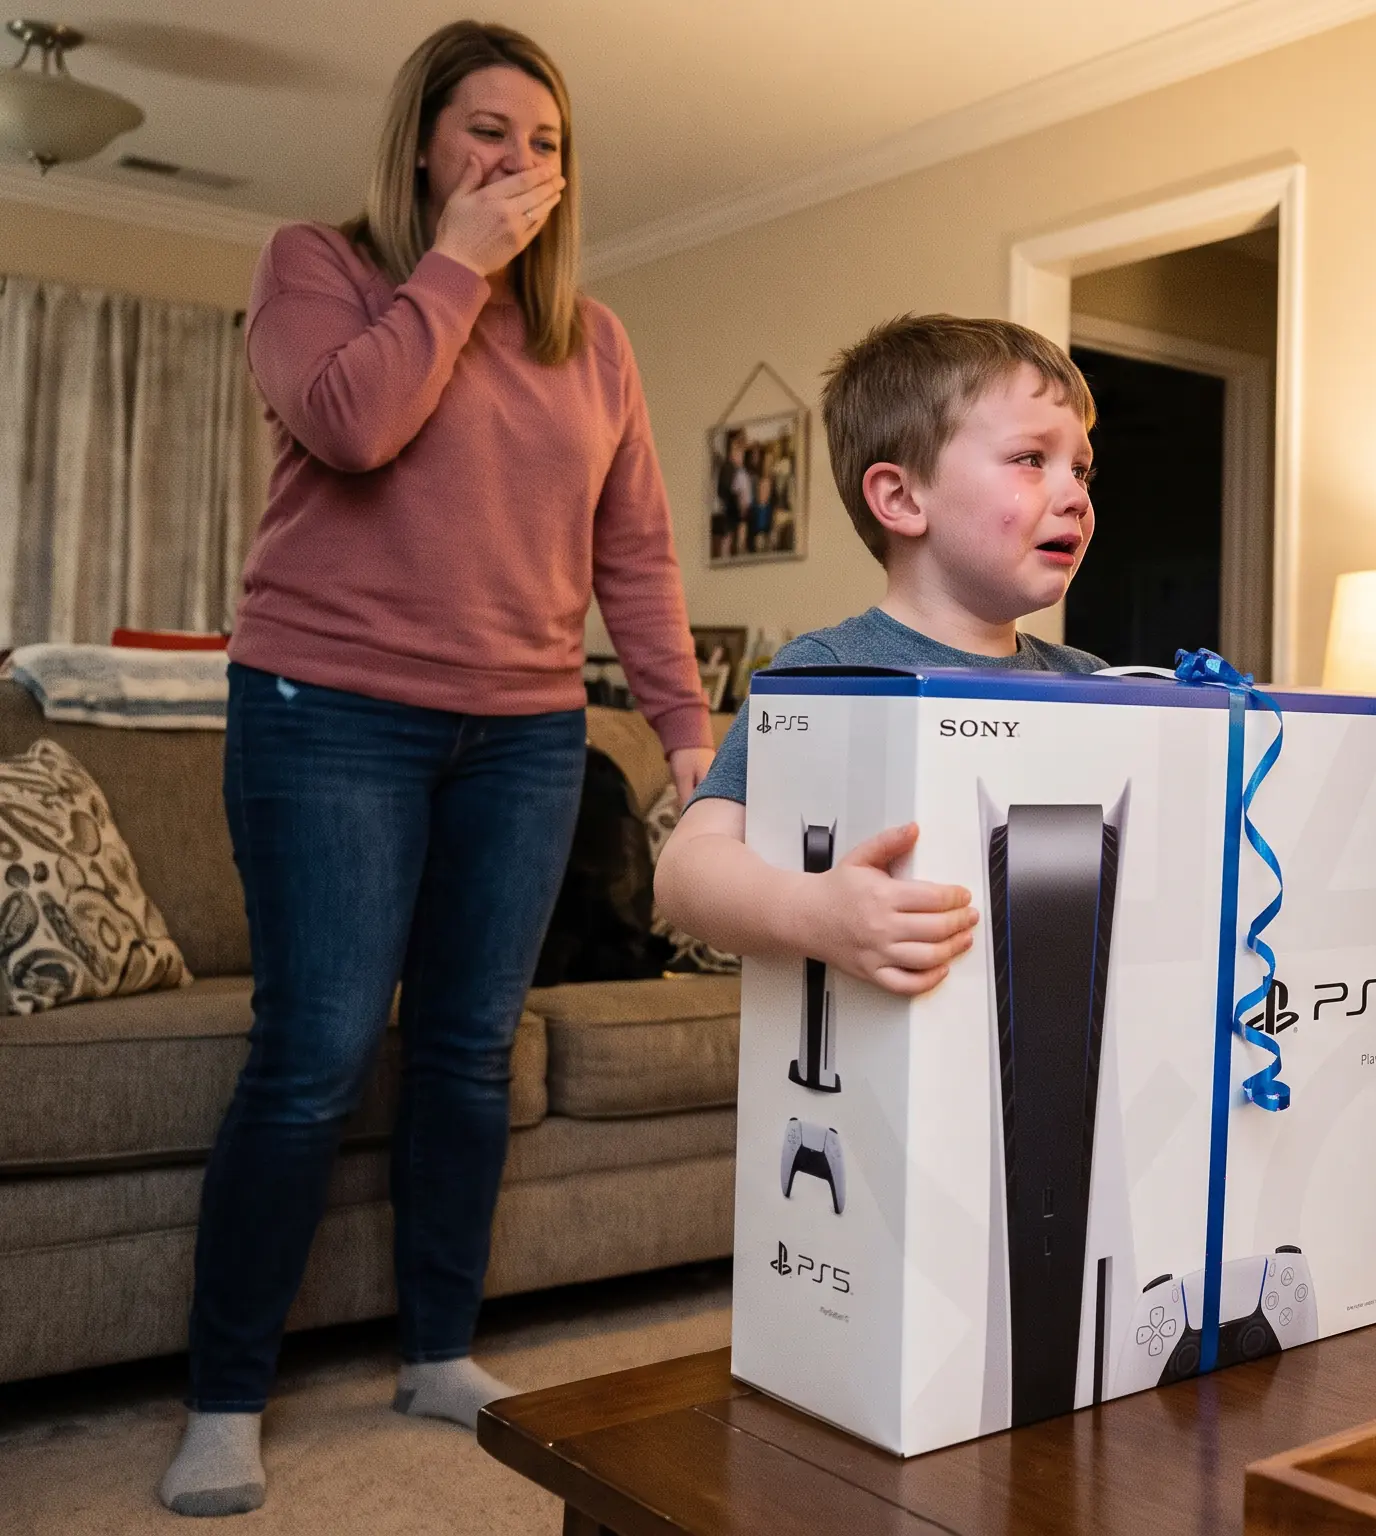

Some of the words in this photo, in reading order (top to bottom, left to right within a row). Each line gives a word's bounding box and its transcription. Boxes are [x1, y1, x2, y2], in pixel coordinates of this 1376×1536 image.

[774, 715, 809, 731] PS5
[939, 719, 1021, 738] SONY
[797, 1253, 851, 1294] PS5
